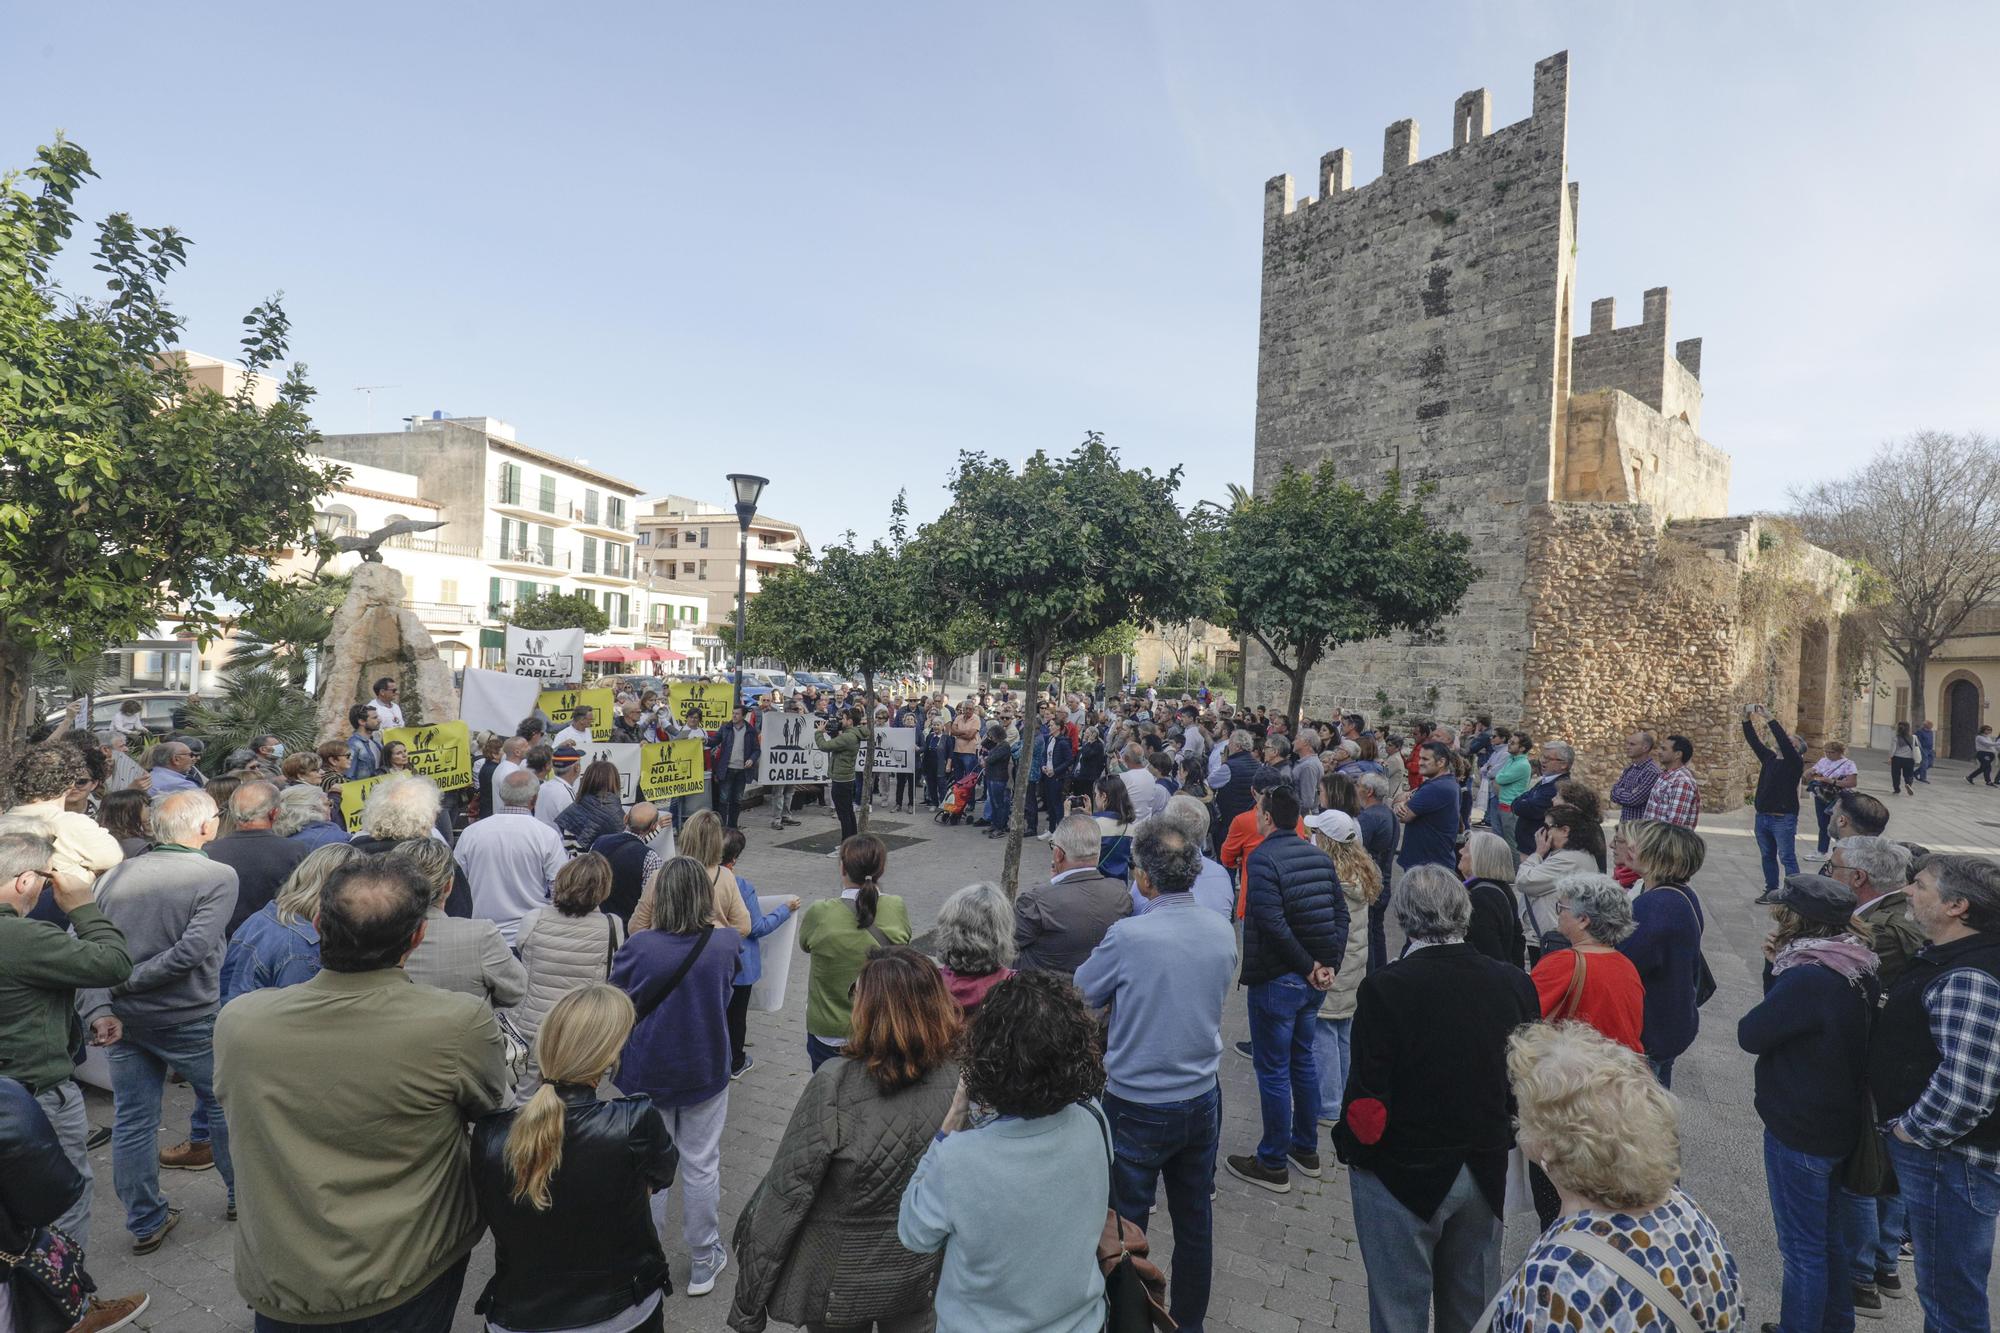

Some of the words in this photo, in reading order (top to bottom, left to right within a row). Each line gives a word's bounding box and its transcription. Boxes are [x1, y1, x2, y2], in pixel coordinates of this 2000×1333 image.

[517, 656, 535, 666] NO
[539, 658, 555, 667] AL
[515, 668, 556, 678] CABLE
[552, 712, 567, 721] NO
[424, 753, 440, 764] AL
[769, 751, 788, 764] NO
[791, 751, 807, 764] AL
[876, 750, 890, 758] AL
[651, 765, 665, 775] NO
[667, 763, 678, 772] AL
[858, 759, 891, 768] CBLE
[419, 764, 441, 776] BLE
[768, 768, 809, 781] CABLE
[435, 771, 470, 789] OBLADAS
[650, 773, 680, 784] CABLE
[643, 788, 655, 798] POR
[654, 785, 673, 797] ZONAS
[673, 780, 704, 794] POBLADAS
